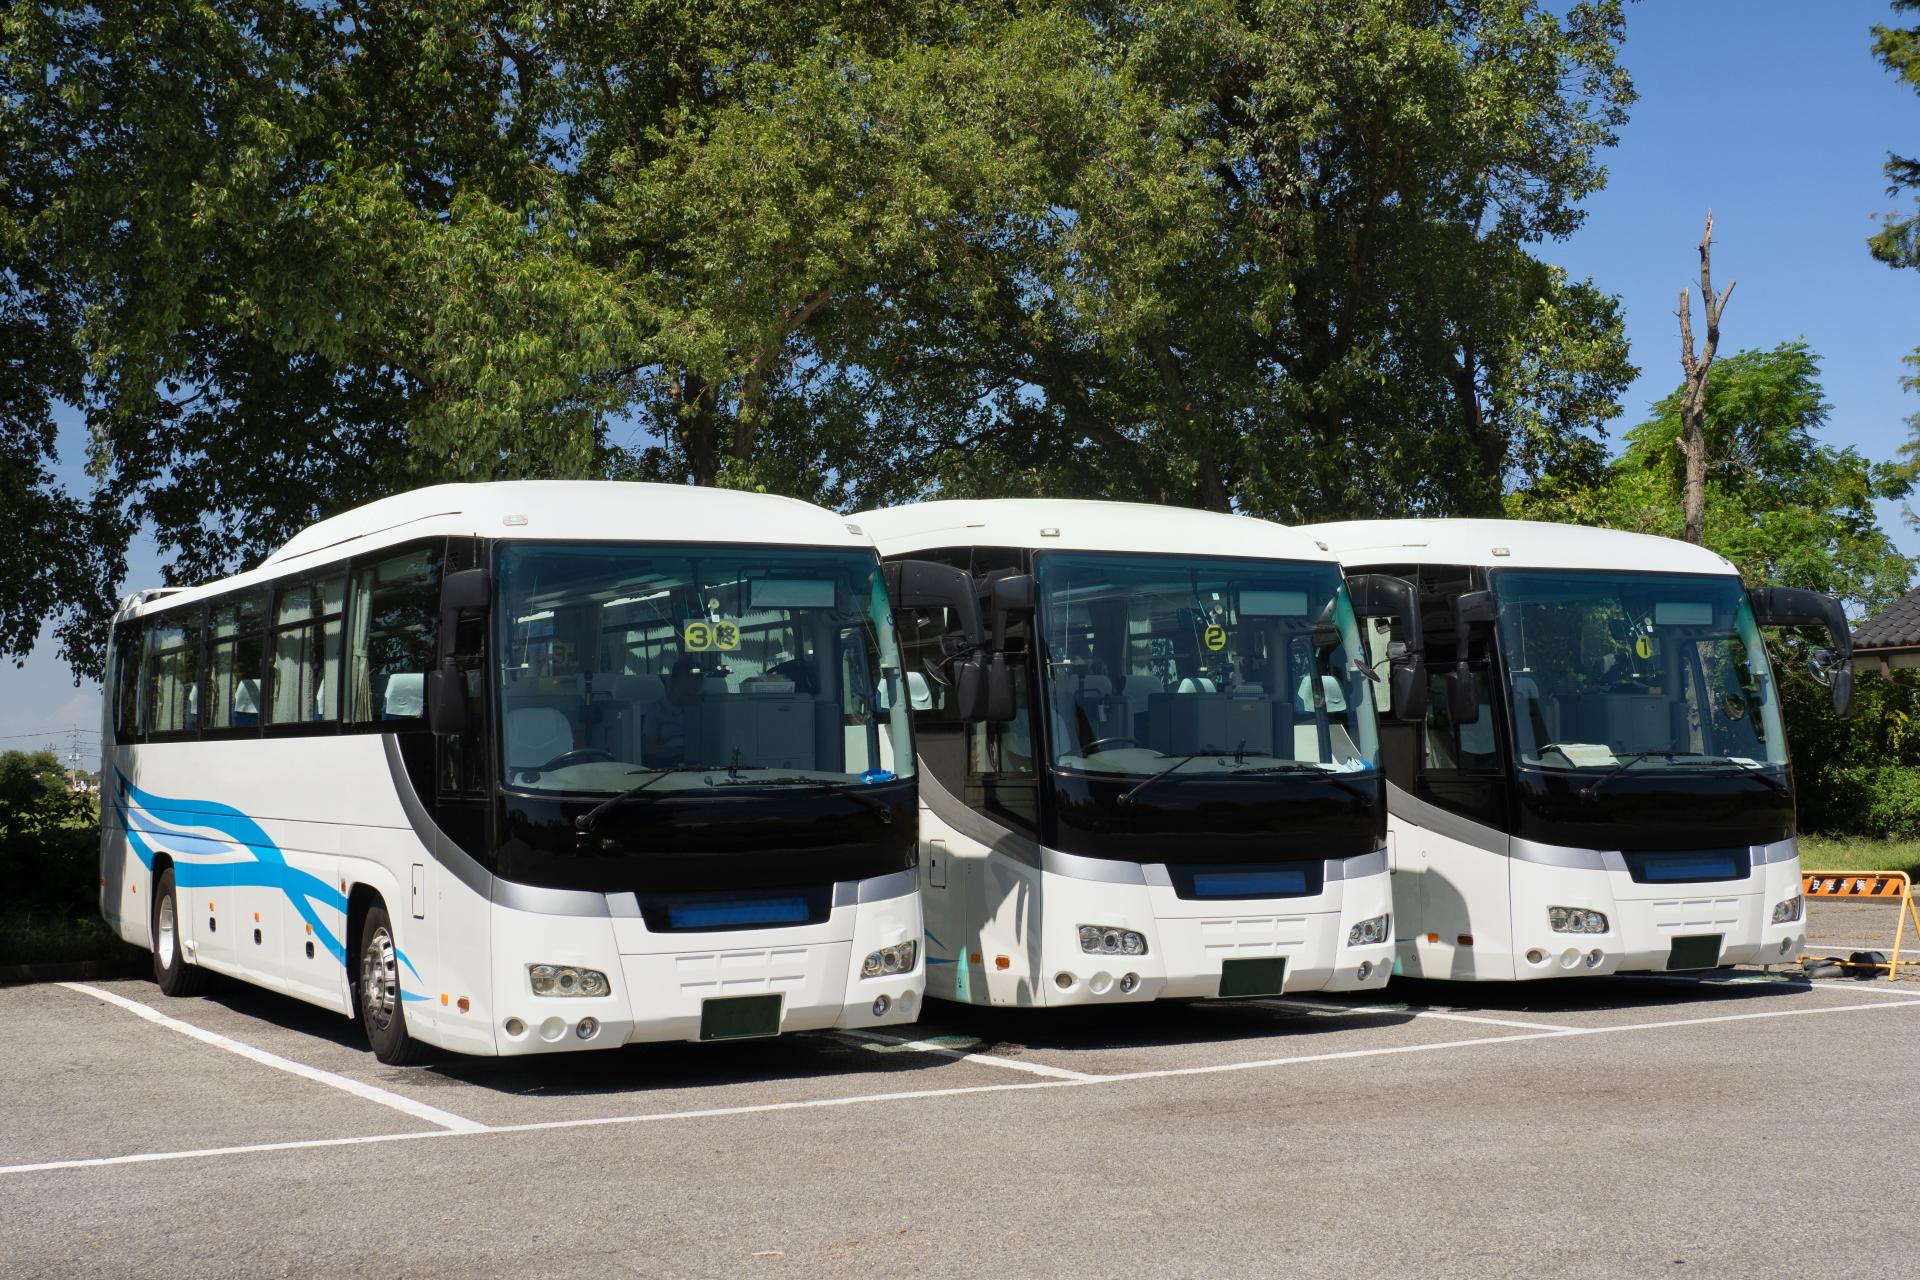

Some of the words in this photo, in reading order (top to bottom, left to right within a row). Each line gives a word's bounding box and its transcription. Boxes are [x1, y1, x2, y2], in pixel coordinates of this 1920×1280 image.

[689, 626, 708, 648] 3
[1207, 627, 1223, 646] 2
[1640, 638, 1648, 656] 1
